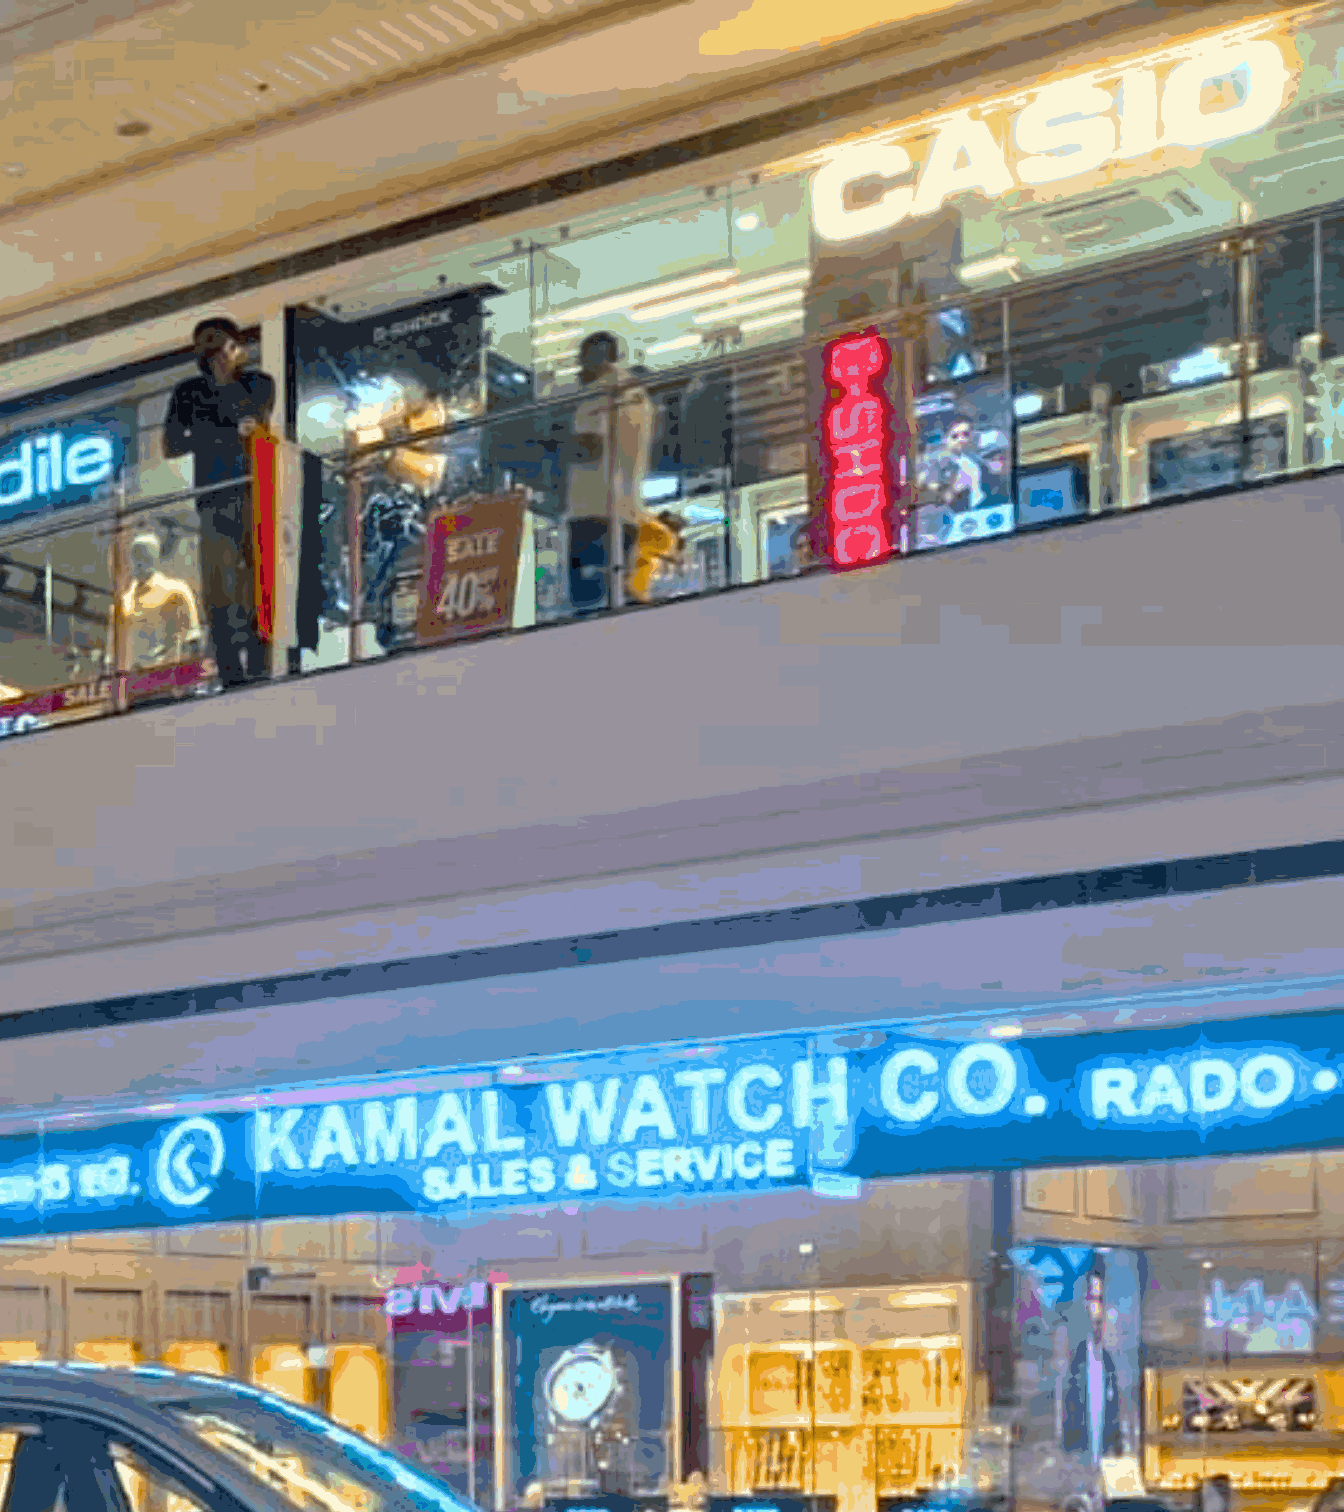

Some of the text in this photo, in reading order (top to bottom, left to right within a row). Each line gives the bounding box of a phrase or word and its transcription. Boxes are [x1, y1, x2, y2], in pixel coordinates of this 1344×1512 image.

[812, 30, 1293, 241] CASIO
[257, 1043, 1295, 1173] KAMAL WATCH CO. RADO
[423, 1139, 795, 1202] SALES & SERVICE
